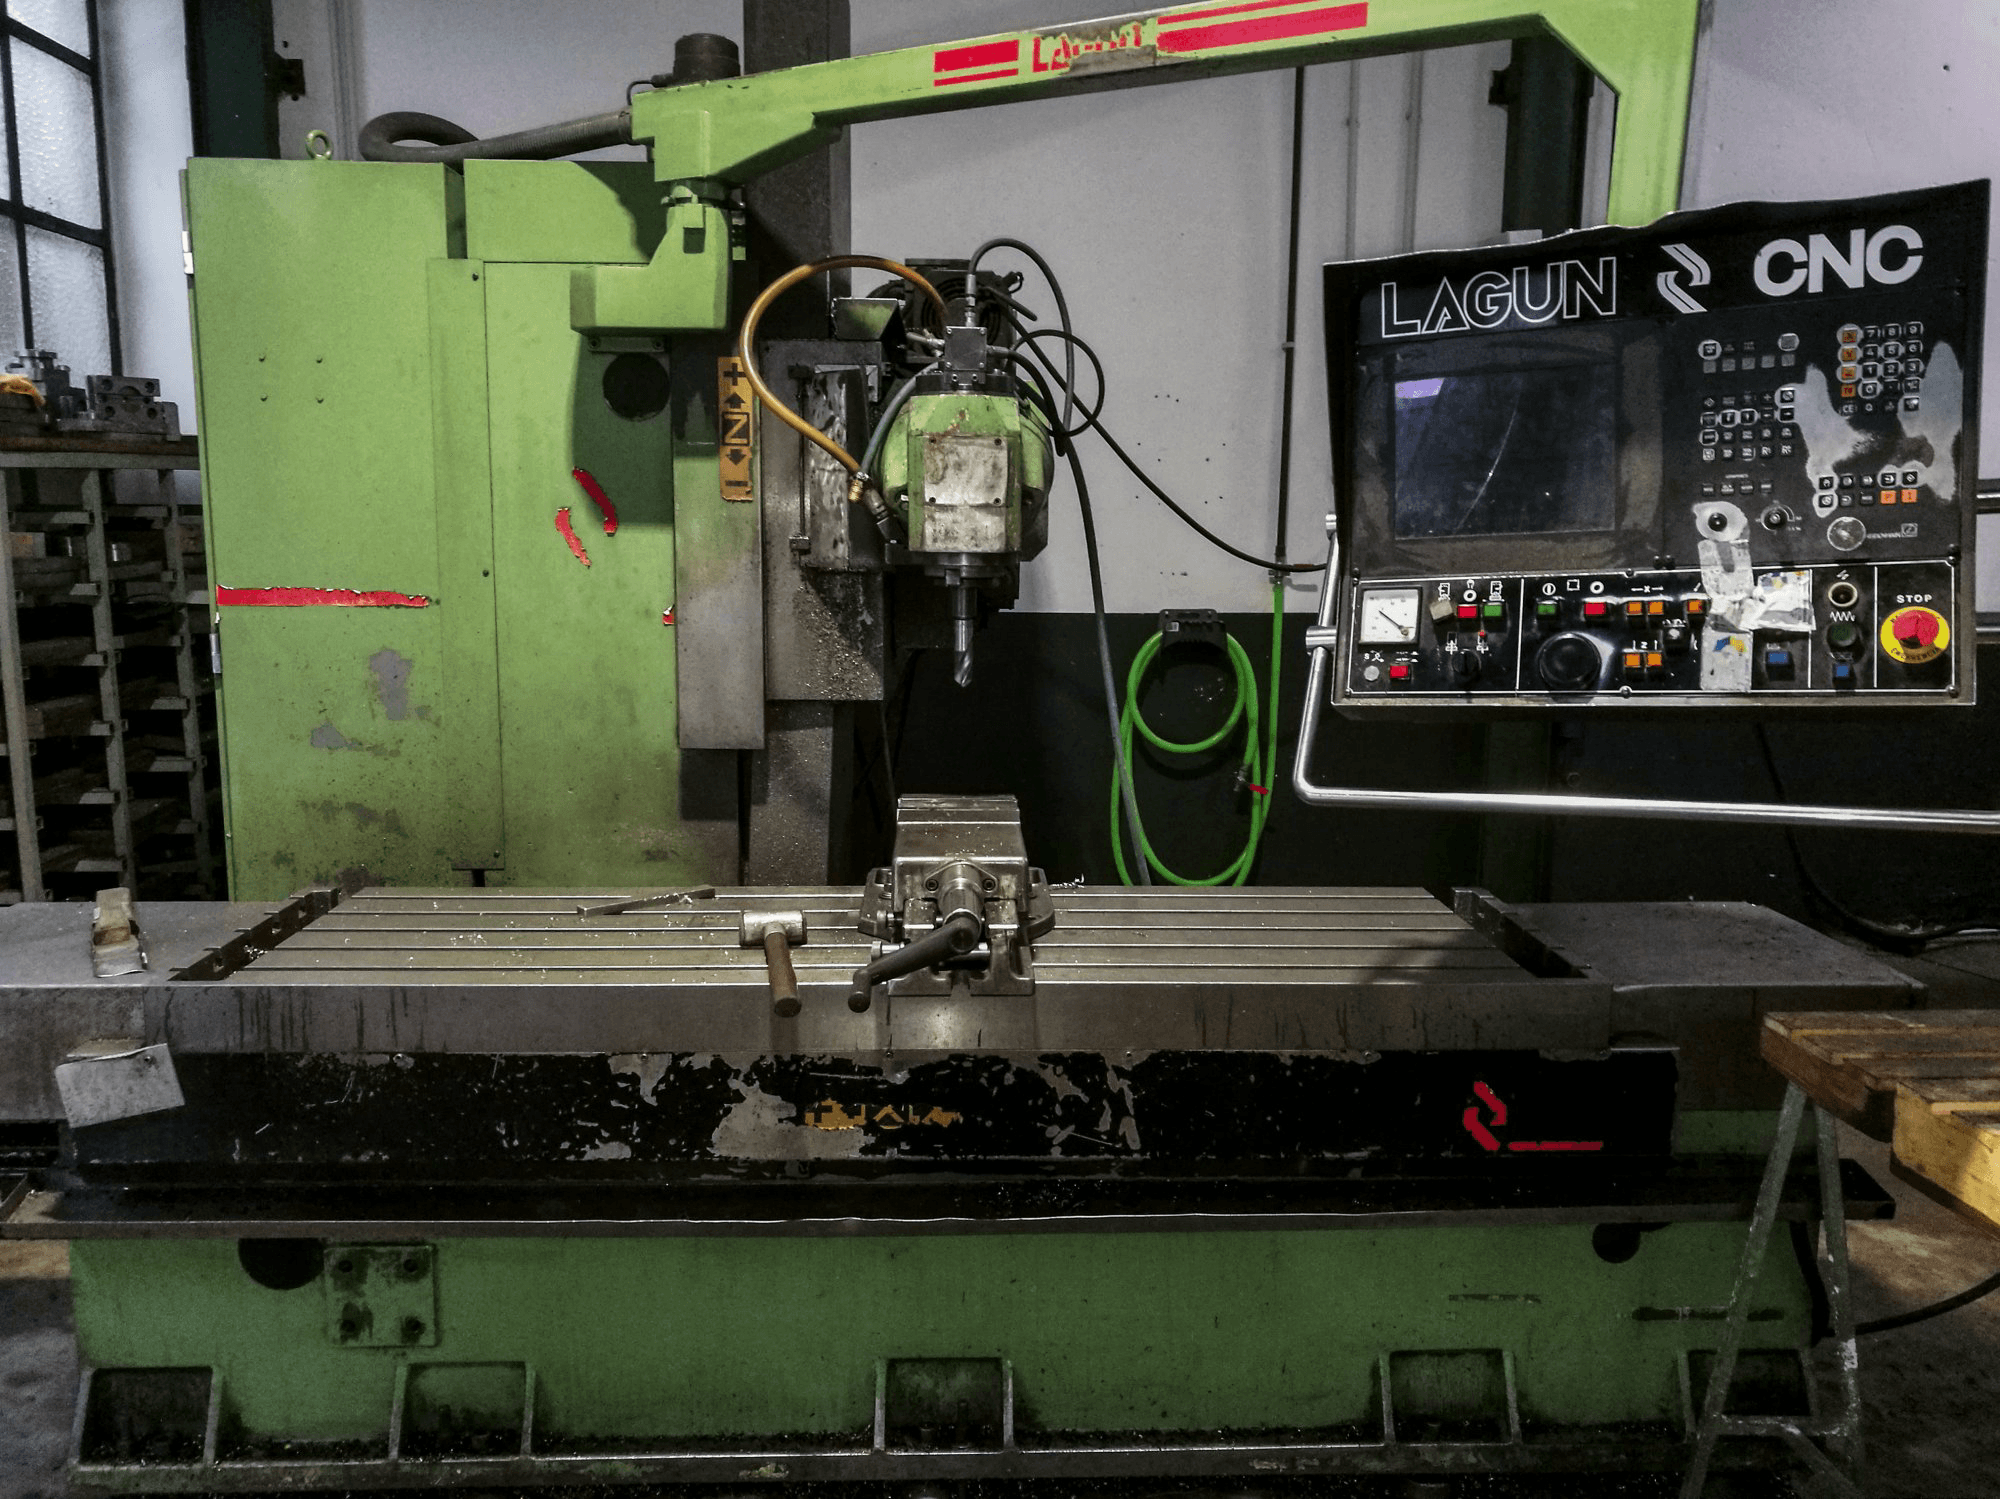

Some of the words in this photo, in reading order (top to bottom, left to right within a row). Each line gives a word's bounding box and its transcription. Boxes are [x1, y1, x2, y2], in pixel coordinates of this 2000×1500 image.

[1382, 256, 1617, 338] LAGUN
[1753, 225, 1924, 297] CNC
[1896, 594, 1932, 603] STOP
